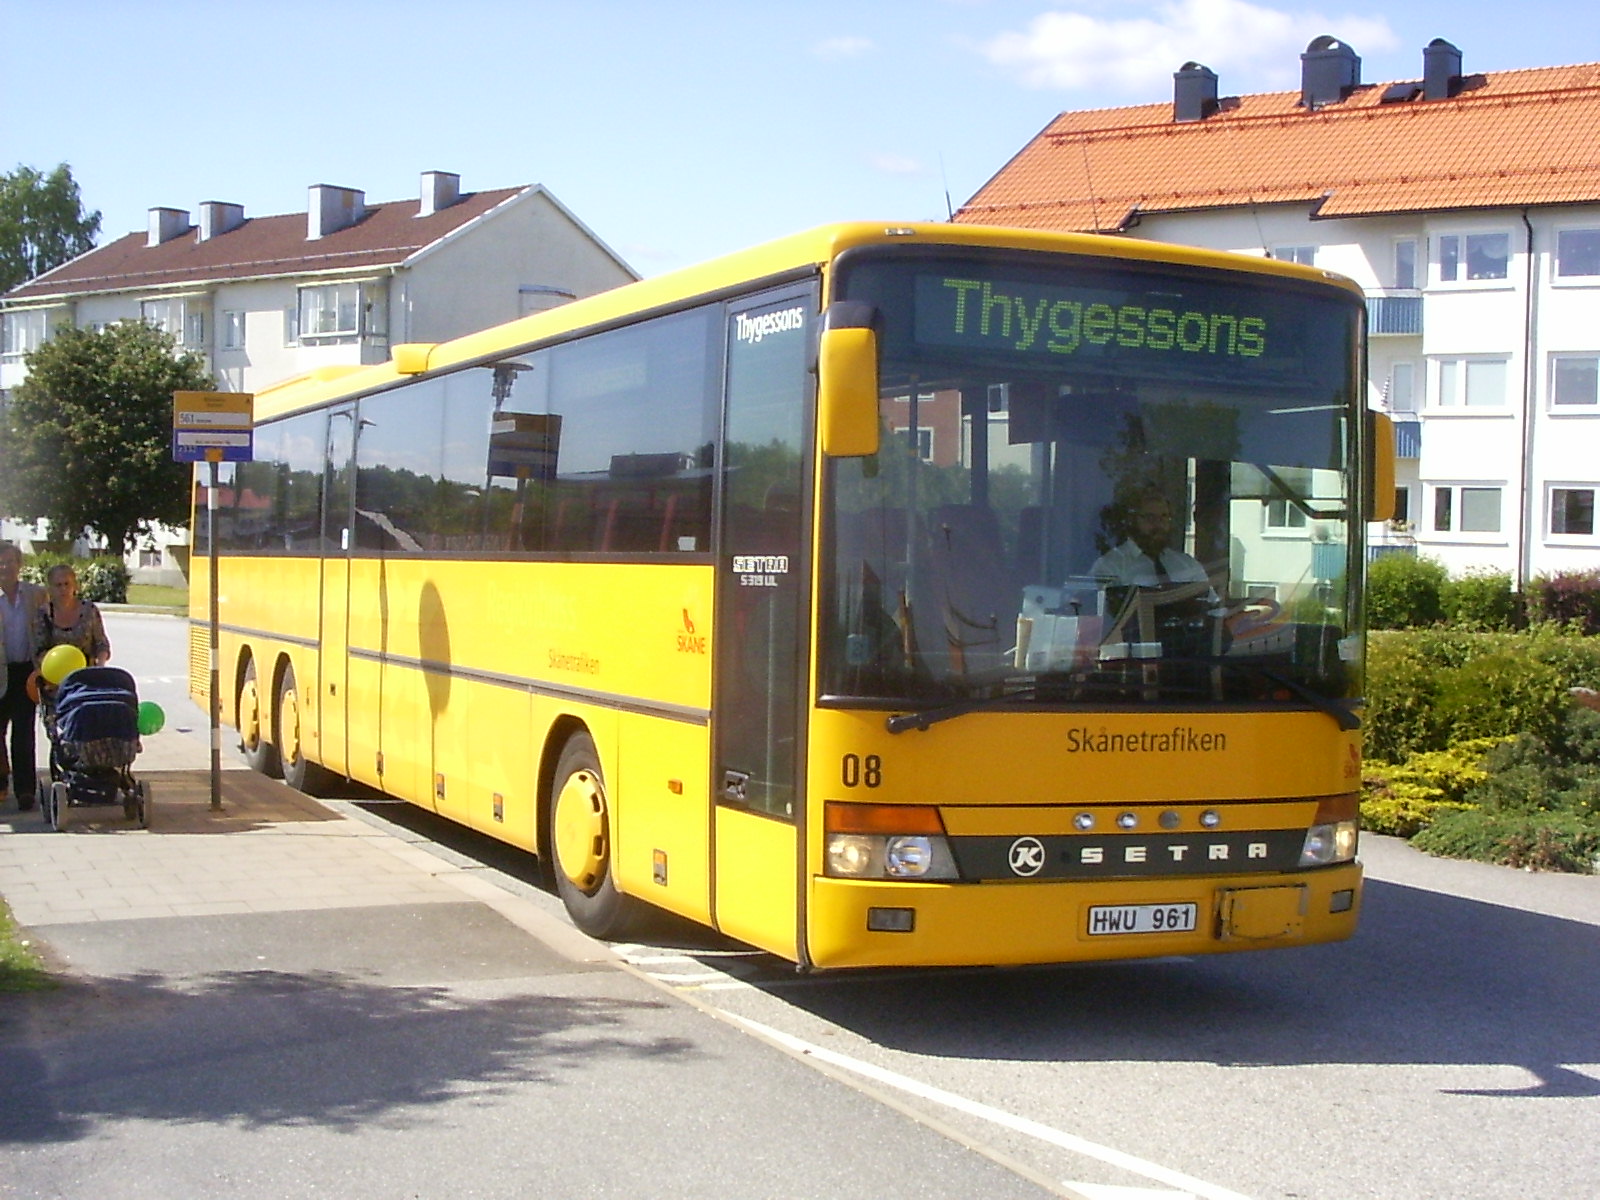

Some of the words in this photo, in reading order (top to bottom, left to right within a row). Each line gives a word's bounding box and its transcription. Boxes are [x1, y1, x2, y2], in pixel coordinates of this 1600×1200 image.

[736, 307, 803, 344] Thygessons
[943, 279, 1266, 357] Thygessons
[733, 555, 789, 573] SETRA
[1066, 726, 1226, 752] Skånetrafiken
[842, 753, 881, 788] 08
[1080, 842, 1268, 865] SETRA
[1093, 910, 1137, 931] HWU
[1152, 907, 1190, 929] 961
